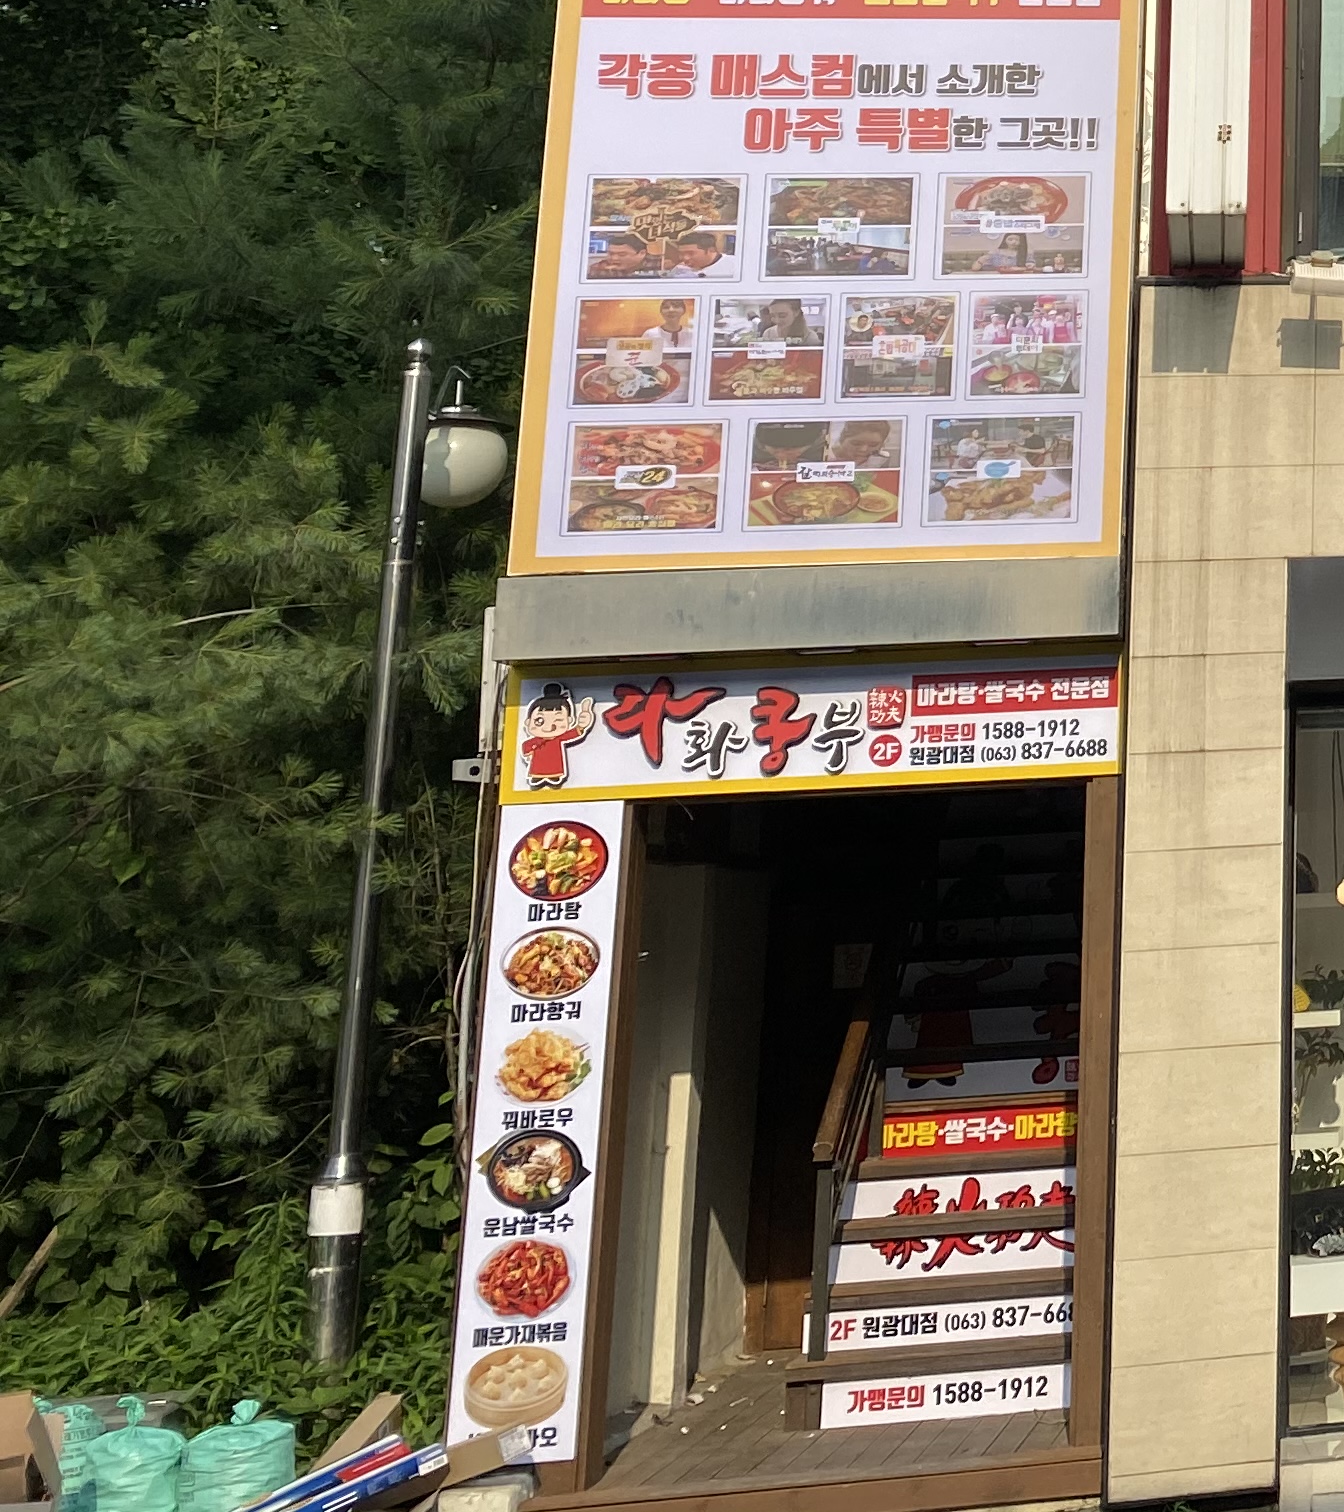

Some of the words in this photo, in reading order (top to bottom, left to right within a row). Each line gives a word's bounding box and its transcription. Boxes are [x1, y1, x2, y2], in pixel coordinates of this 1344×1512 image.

[596, 53, 698, 99] 각종
[708, 53, 928, 100] 매스컴에서
[935, 61, 1043, 97] 소개한
[742, 107, 841, 153] 아주
[855, 107, 990, 153] 특별한
[996, 115, 1100, 151] 그곳!!
[1050, 675, 1111, 701] 전문점
[604, 676, 864, 778] 라화쿵부
[910, 722, 977, 745] 가맹문의
[981, 718, 1081, 741] 1588-1912
[872, 742, 899, 761] 2F
[908, 744, 976, 766] 원광대점
[980, 744, 1018, 763] (063)
[1020, 738, 1109, 761] 837-6688
[526, 901, 583, 923] 마라탕
[510, 1001, 583, 1024] 마라향궈
[501, 1106, 575, 1133] 꿔바로우
[482, 1212, 575, 1239] 운남쌀국수
[829, 1318, 858, 1342] 2F
[861, 1311, 938, 1340] 원광대점
[944, 1310, 987, 1334] (063)
[991, 1300, 1075, 1329] 837-66
[471, 1321, 568, 1349] 매운가재볶음
[846, 1384, 926, 1415] 가맹문의
[932, 1375, 1049, 1407] 1588-1912
